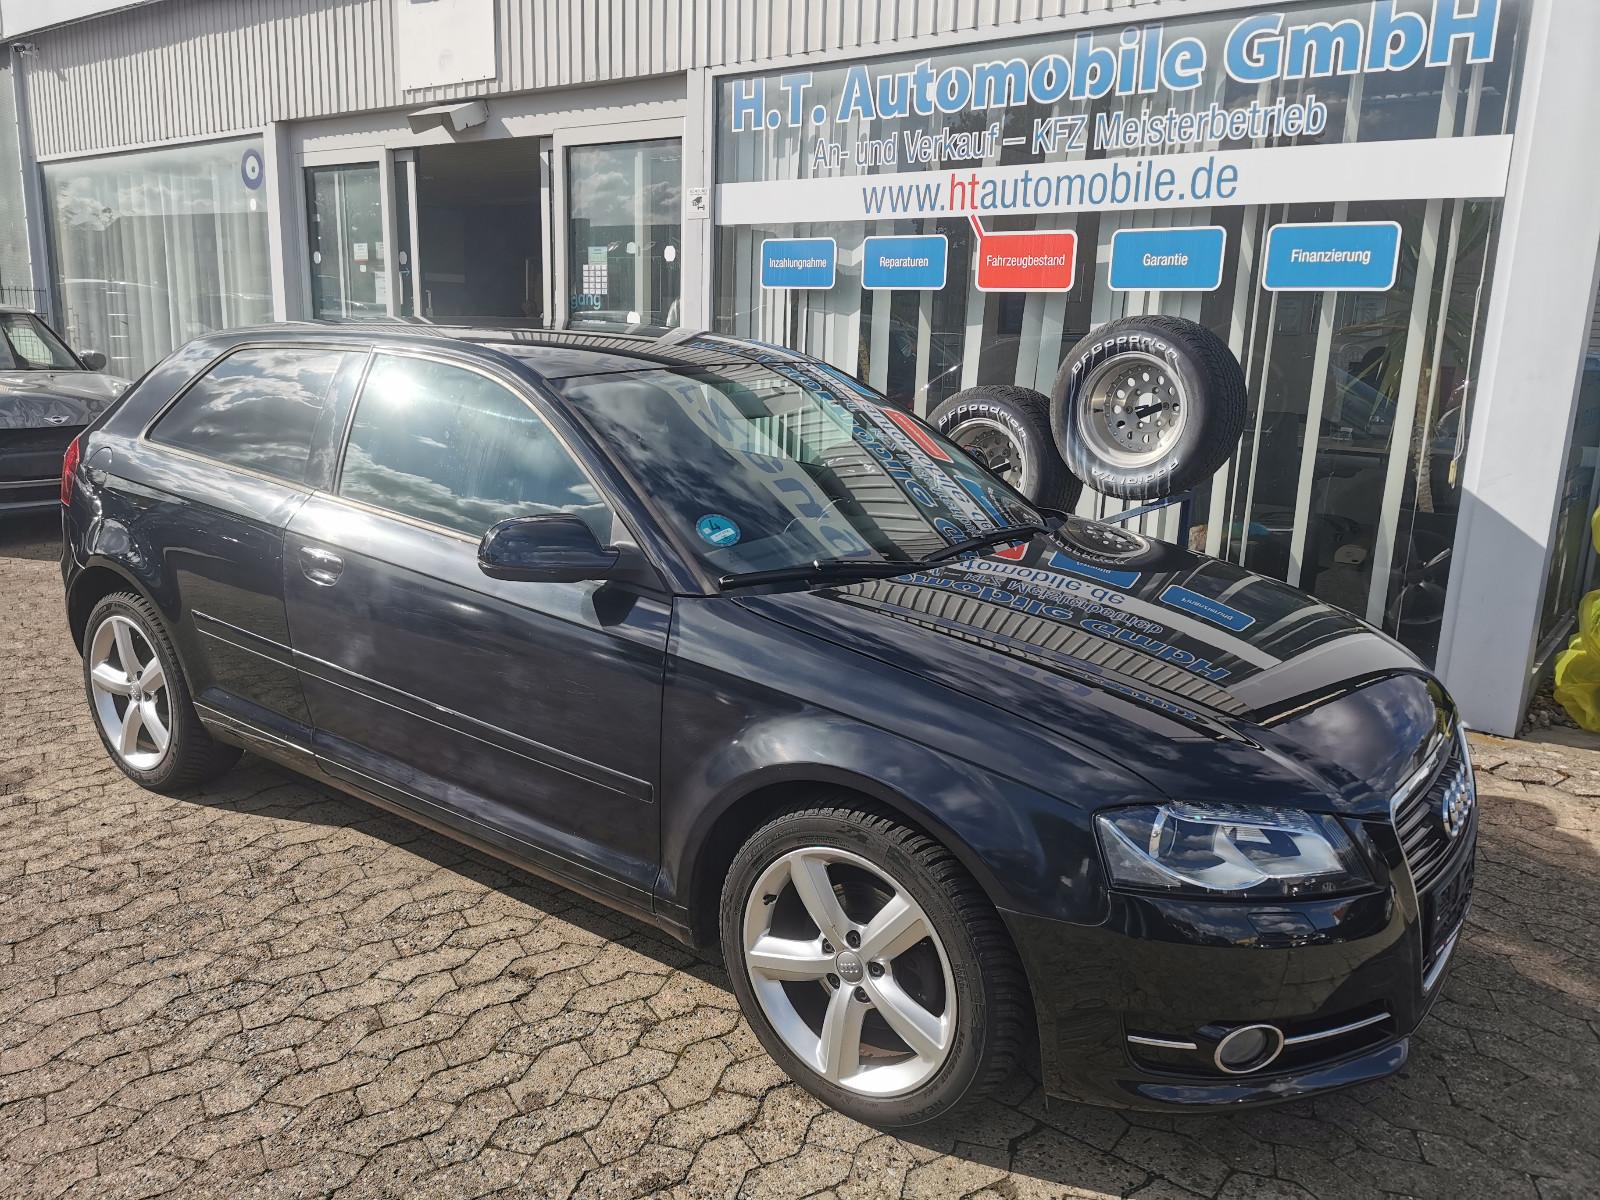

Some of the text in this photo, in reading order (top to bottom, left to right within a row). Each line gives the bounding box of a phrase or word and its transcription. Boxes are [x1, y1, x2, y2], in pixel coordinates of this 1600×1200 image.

[731, 0, 1501, 132] H.T. Automobile GmbH
[812, 137, 849, 169] An-
[855, 132, 897, 167] und
[904, 122, 999, 164] Verkauf
[1031, 116, 1086, 155] KFZ
[1093, 94, 1328, 151] Meisterbetrieb
[861, 156, 1239, 215] www.htautomobile.de
[768, 256, 827, 270] Inzahlungnahme
[879, 256, 929, 270] Reparaturen
[986, 254, 1065, 268] Fahrzeugbestand
[1142, 252, 1189, 266] Garantie
[1289, 248, 1372, 265] Finanzierung
